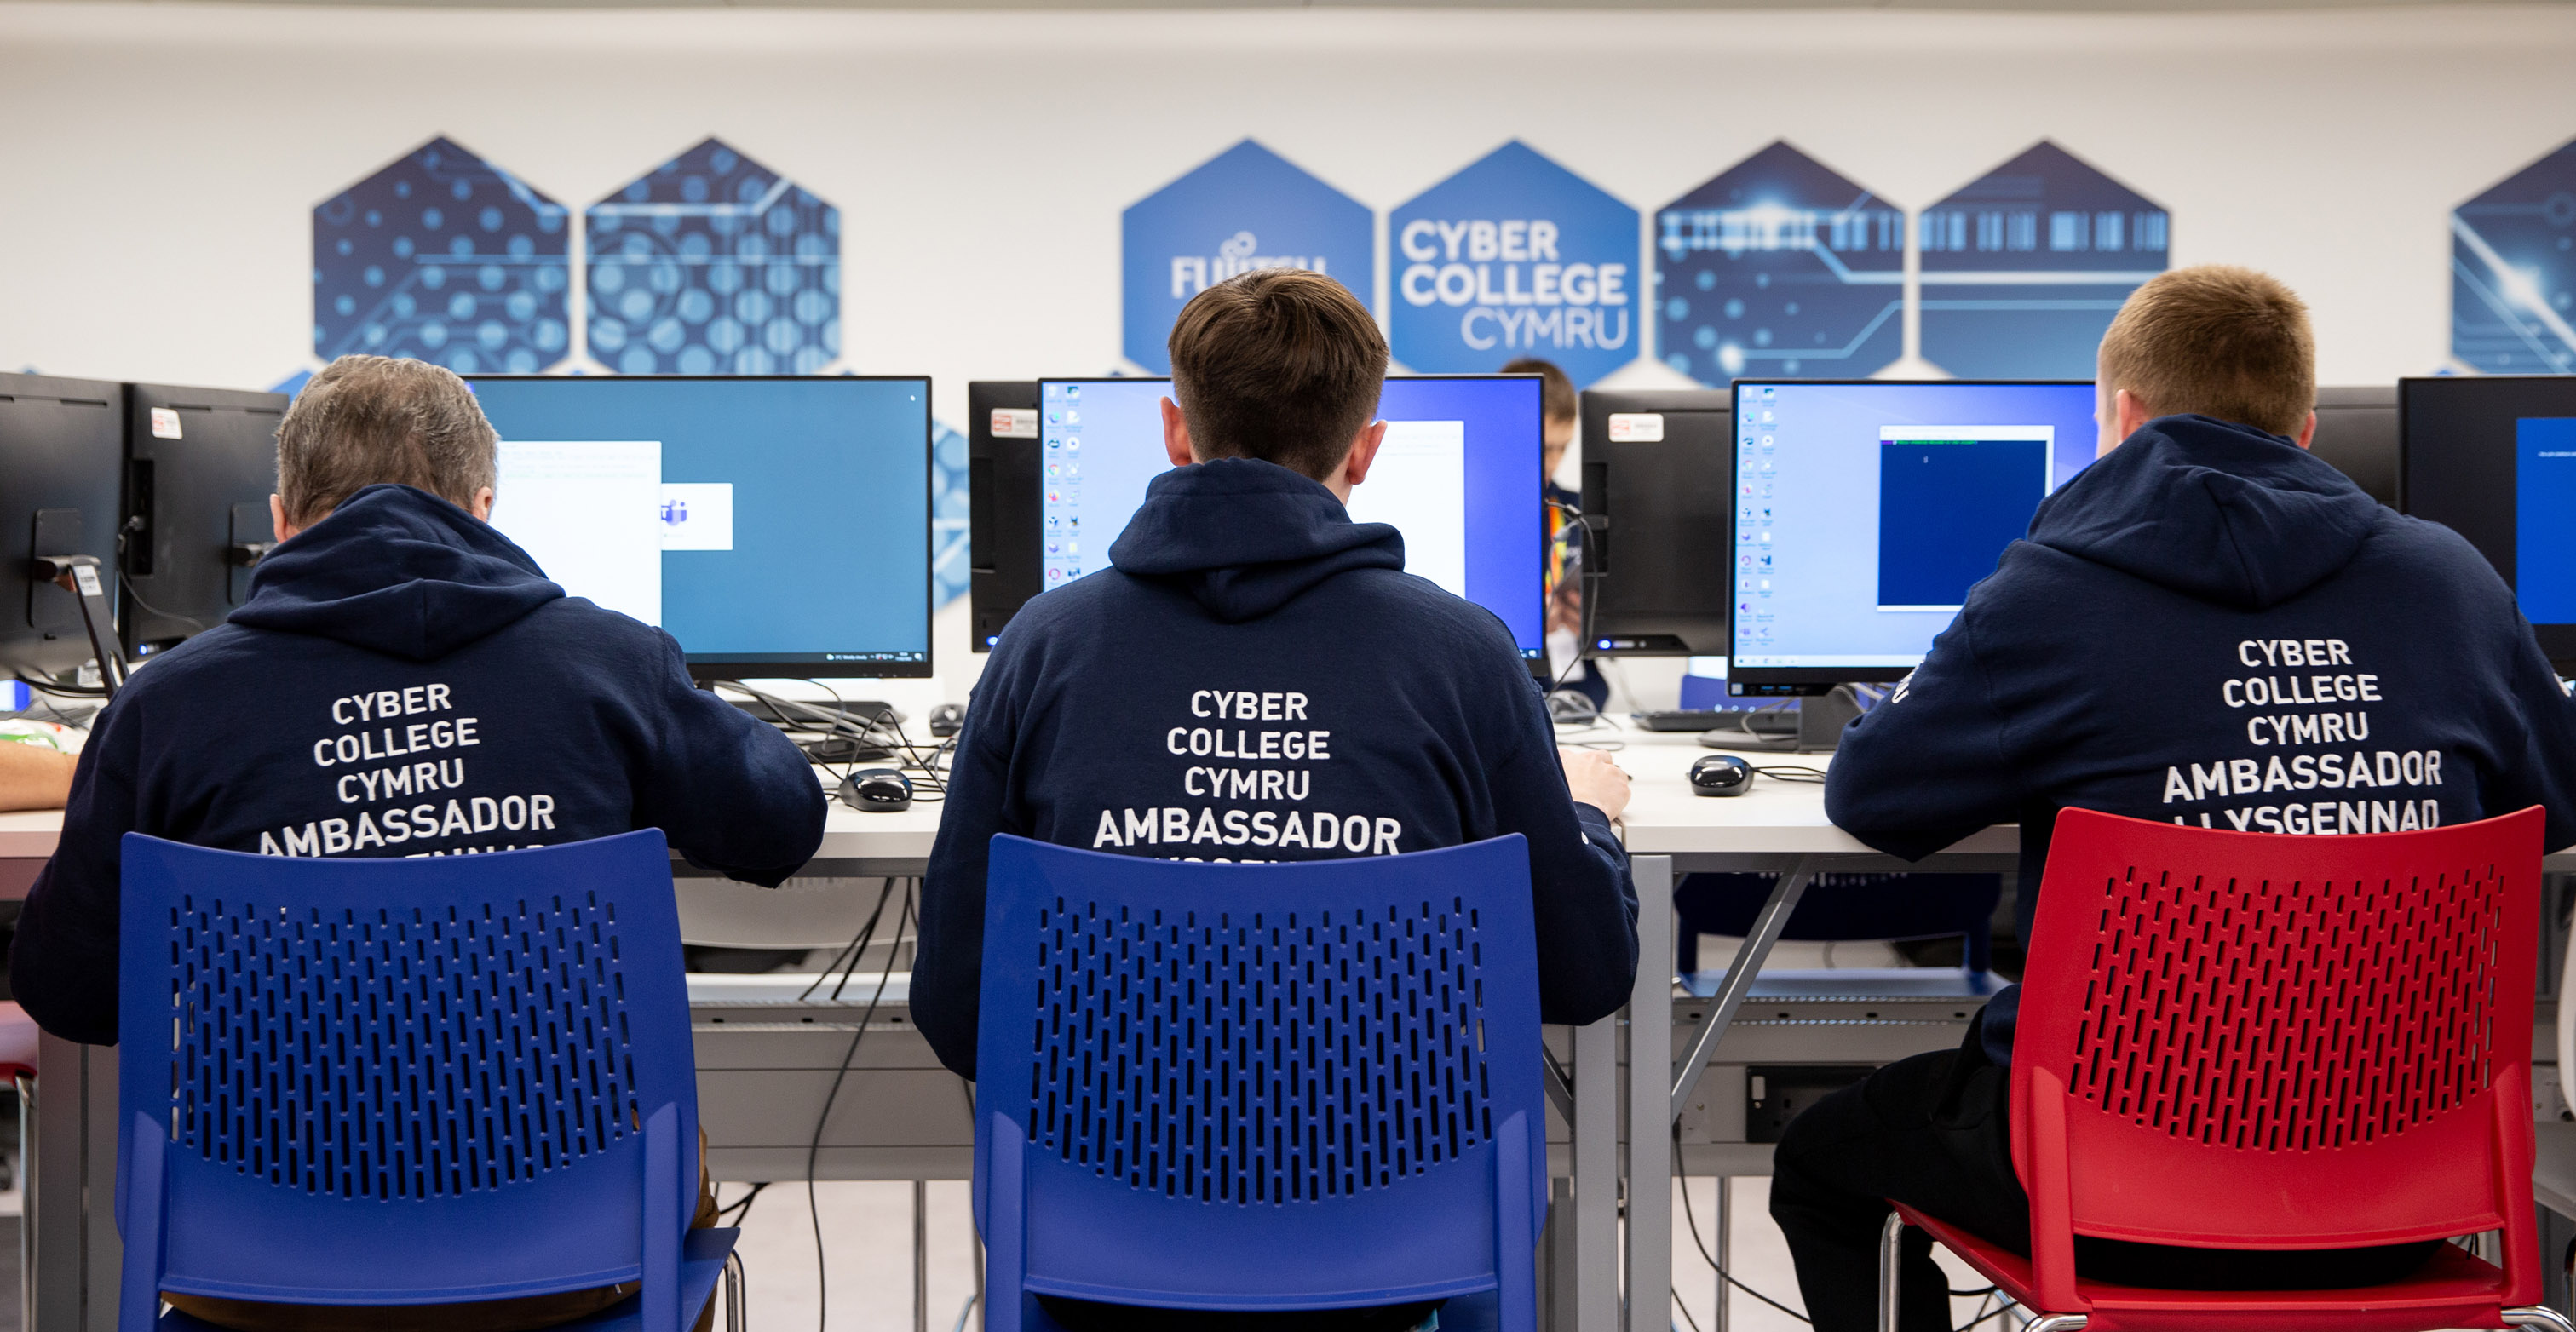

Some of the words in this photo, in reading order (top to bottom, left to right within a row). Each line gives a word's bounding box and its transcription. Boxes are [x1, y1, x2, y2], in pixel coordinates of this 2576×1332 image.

[1400, 219, 1559, 262] CYBER
[1400, 263, 1628, 307] COLLEGE
[1461, 307, 1629, 351] CYMRU
[2238, 639, 2353, 668] CYBER
[332, 683, 452, 725] CYBER
[1191, 690, 1308, 721] CYBER
[2222, 674, 2383, 708] COLLEGE
[313, 718, 480, 767] COLLEGE
[1167, 726, 1331, 760] COLLEGE
[2247, 711, 2369, 746] CYMRU
[337, 757, 464, 803] CYMRU
[1184, 766, 1310, 801] CYMRU
[2162, 750, 2443, 803] AMBASSADOR
[259, 794, 555, 858] AMBASSADOR
[1093, 807, 1401, 856] AMBASSADOR
[2174, 799, 2440, 835] YSGENNAD
